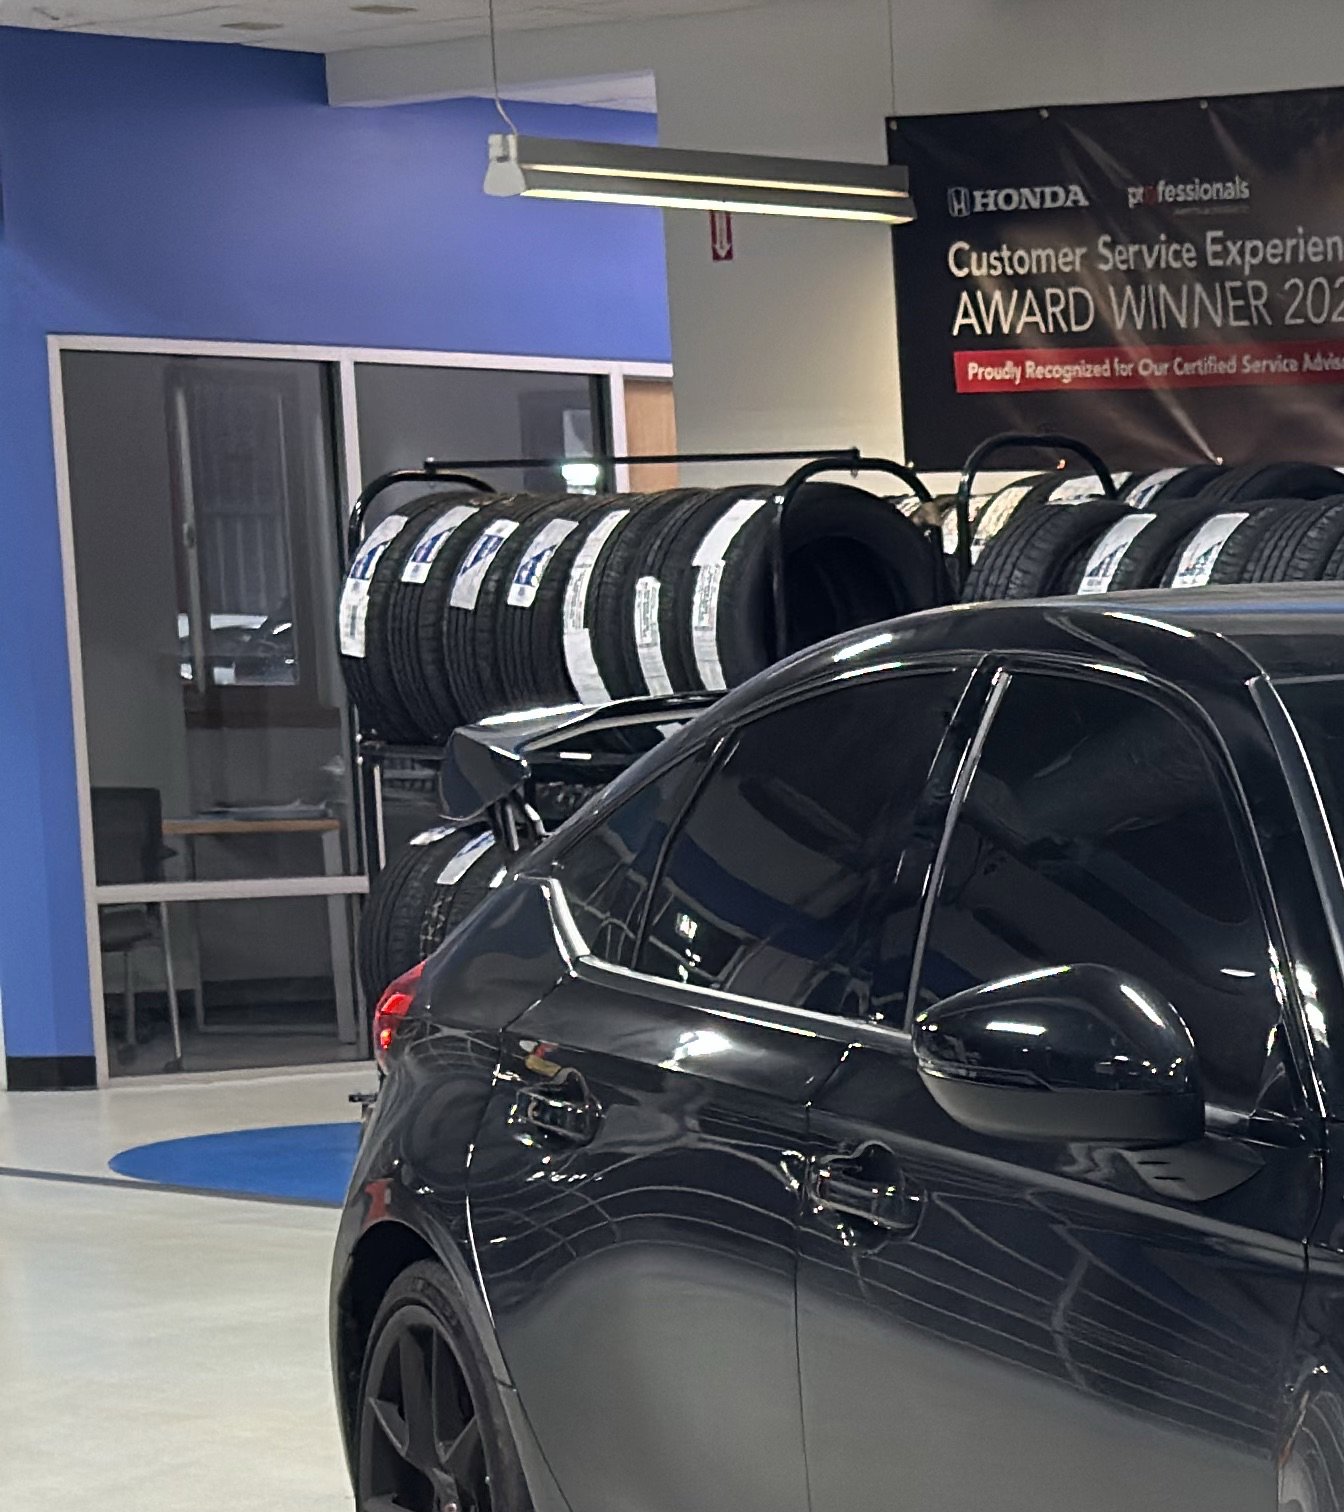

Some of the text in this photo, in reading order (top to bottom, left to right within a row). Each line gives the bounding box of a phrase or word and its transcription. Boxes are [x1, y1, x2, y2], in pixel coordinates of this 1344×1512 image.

[972, 185, 1090, 213] HONDA
[948, 241, 1087, 277] Customer
[1097, 233, 1197, 272] Service
[952, 287, 1095, 336] AWARD
[1108, 280, 1273, 330] WINNER
[967, 360, 1022, 385] Proudly
[1025, 358, 1111, 383] Recognized
[1113, 357, 1134, 377] for
[1138, 357, 1169, 377] Our
[1173, 354, 1237, 376] Certified
[1241, 354, 1299, 374] Service
